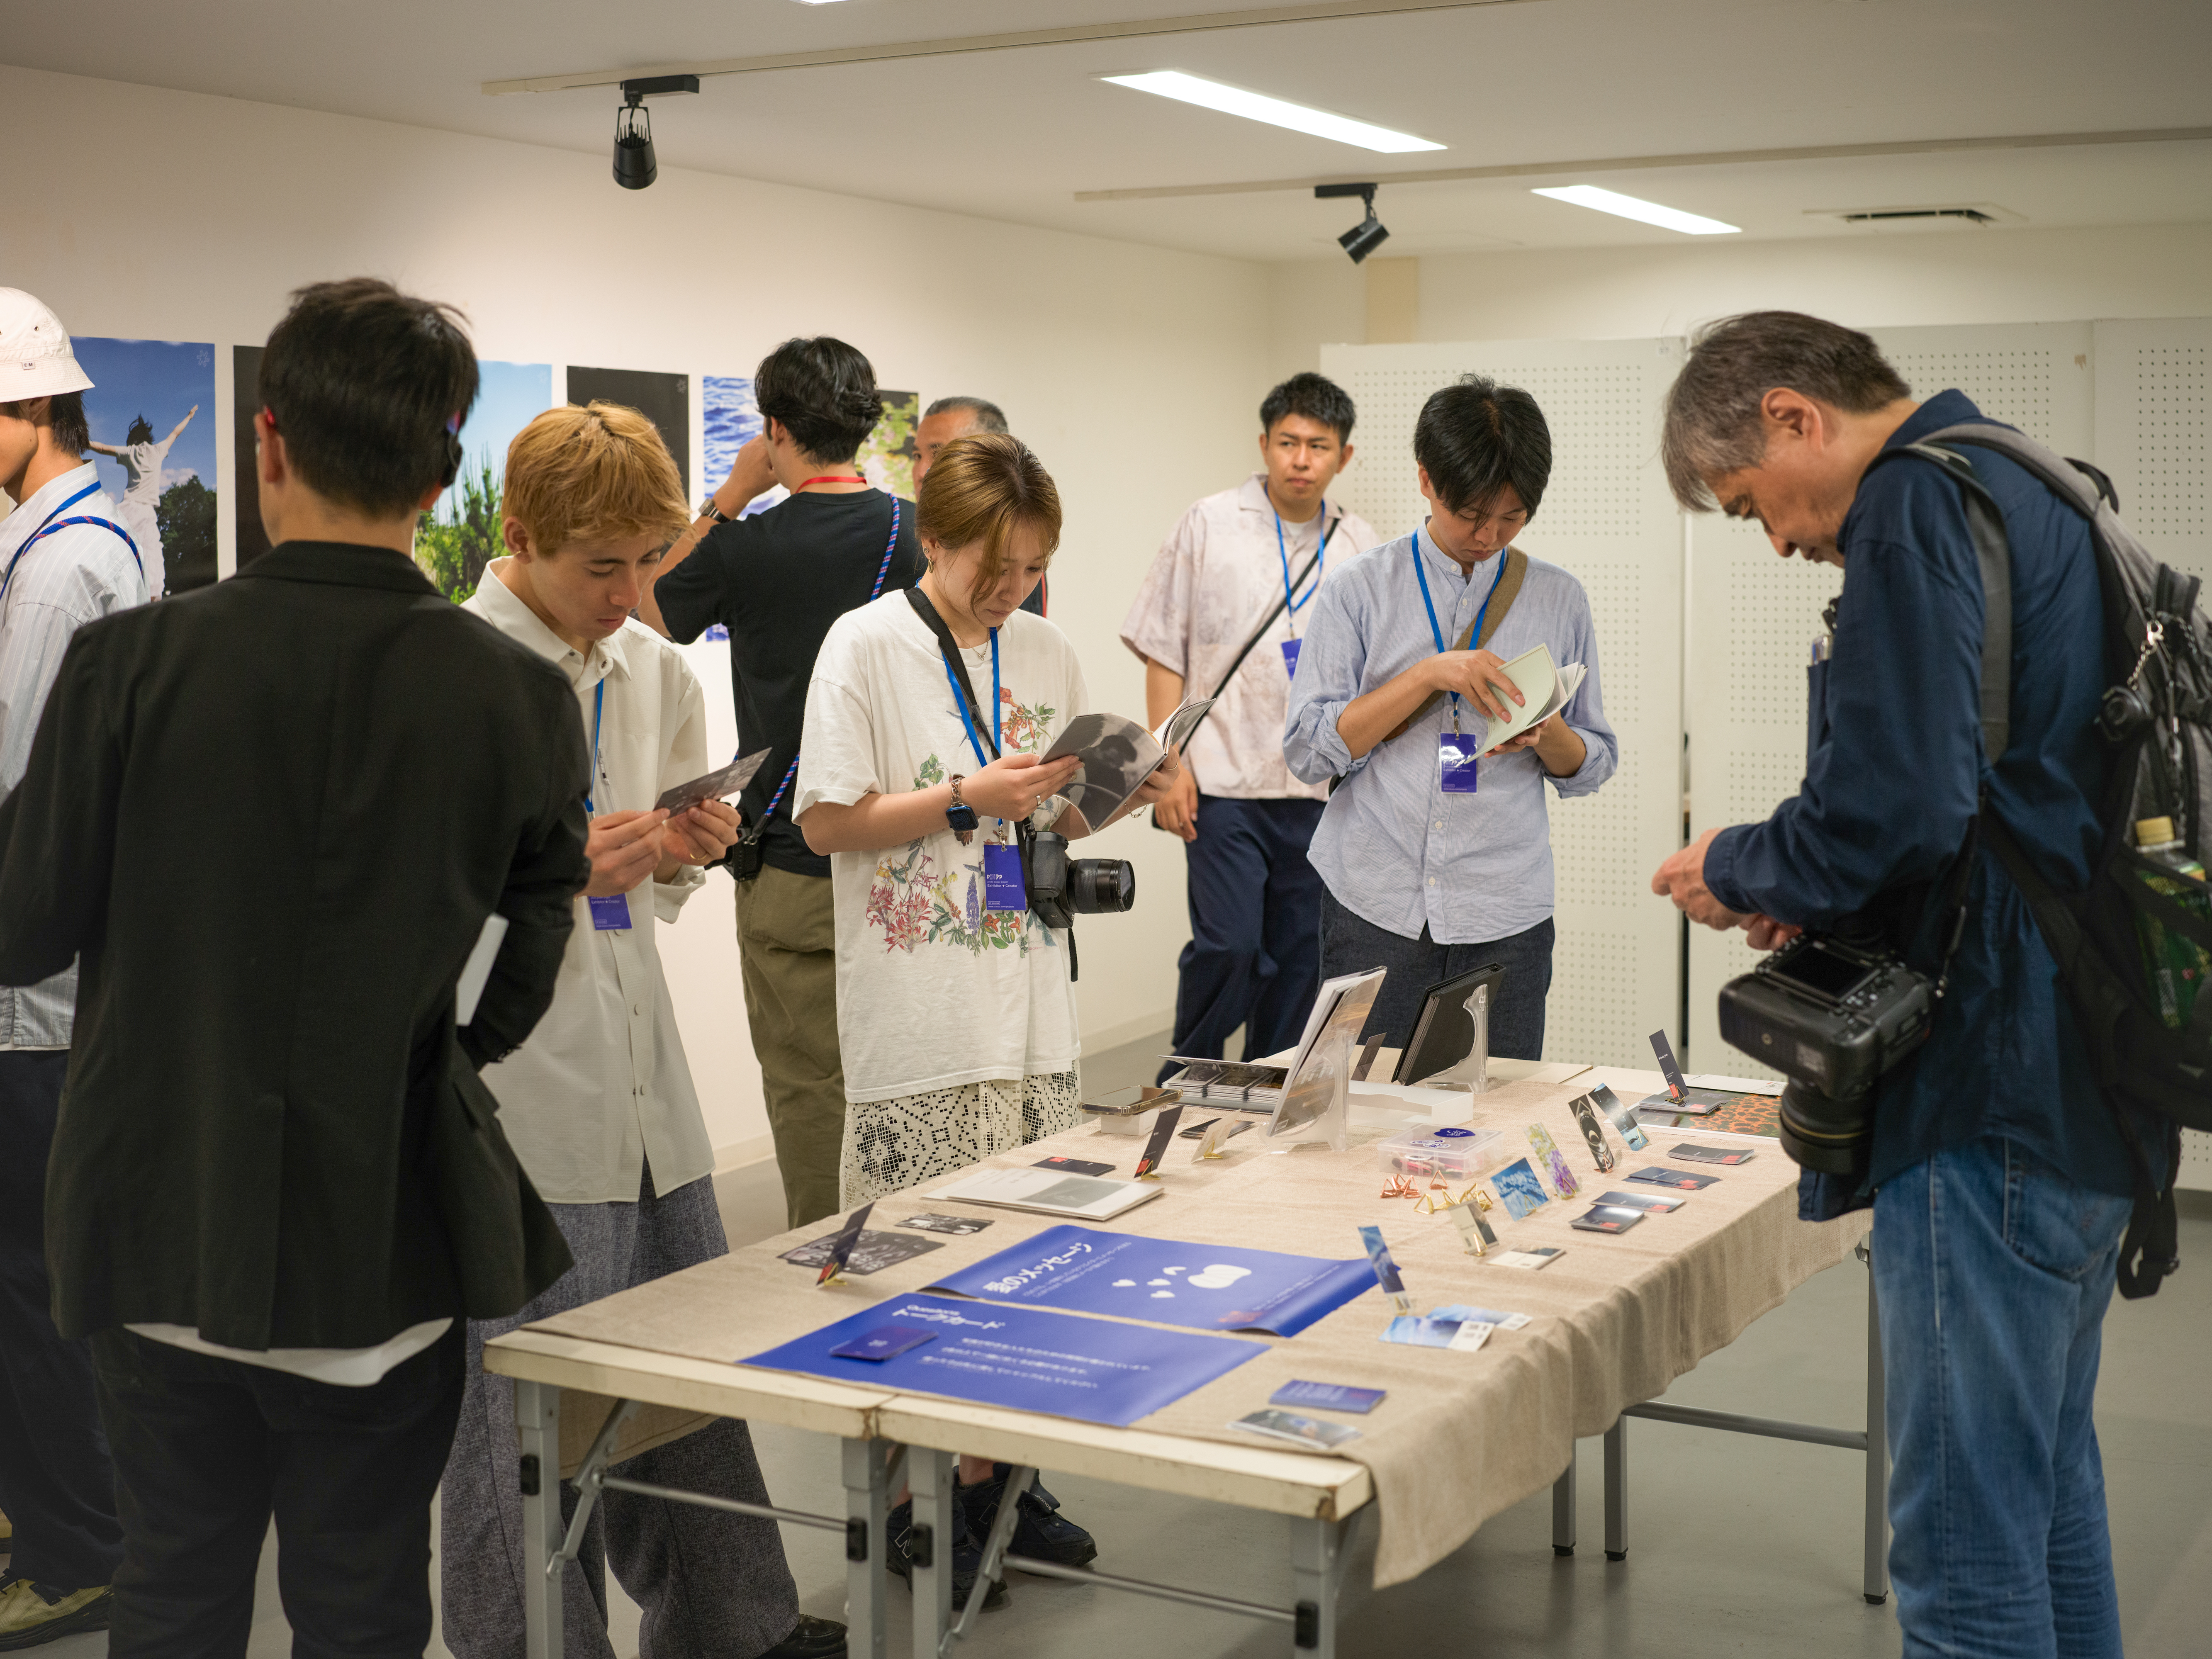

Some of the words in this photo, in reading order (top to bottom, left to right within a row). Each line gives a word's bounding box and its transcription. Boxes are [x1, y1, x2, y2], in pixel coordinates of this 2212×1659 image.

[892, 1308, 1006, 1329] トークカード
